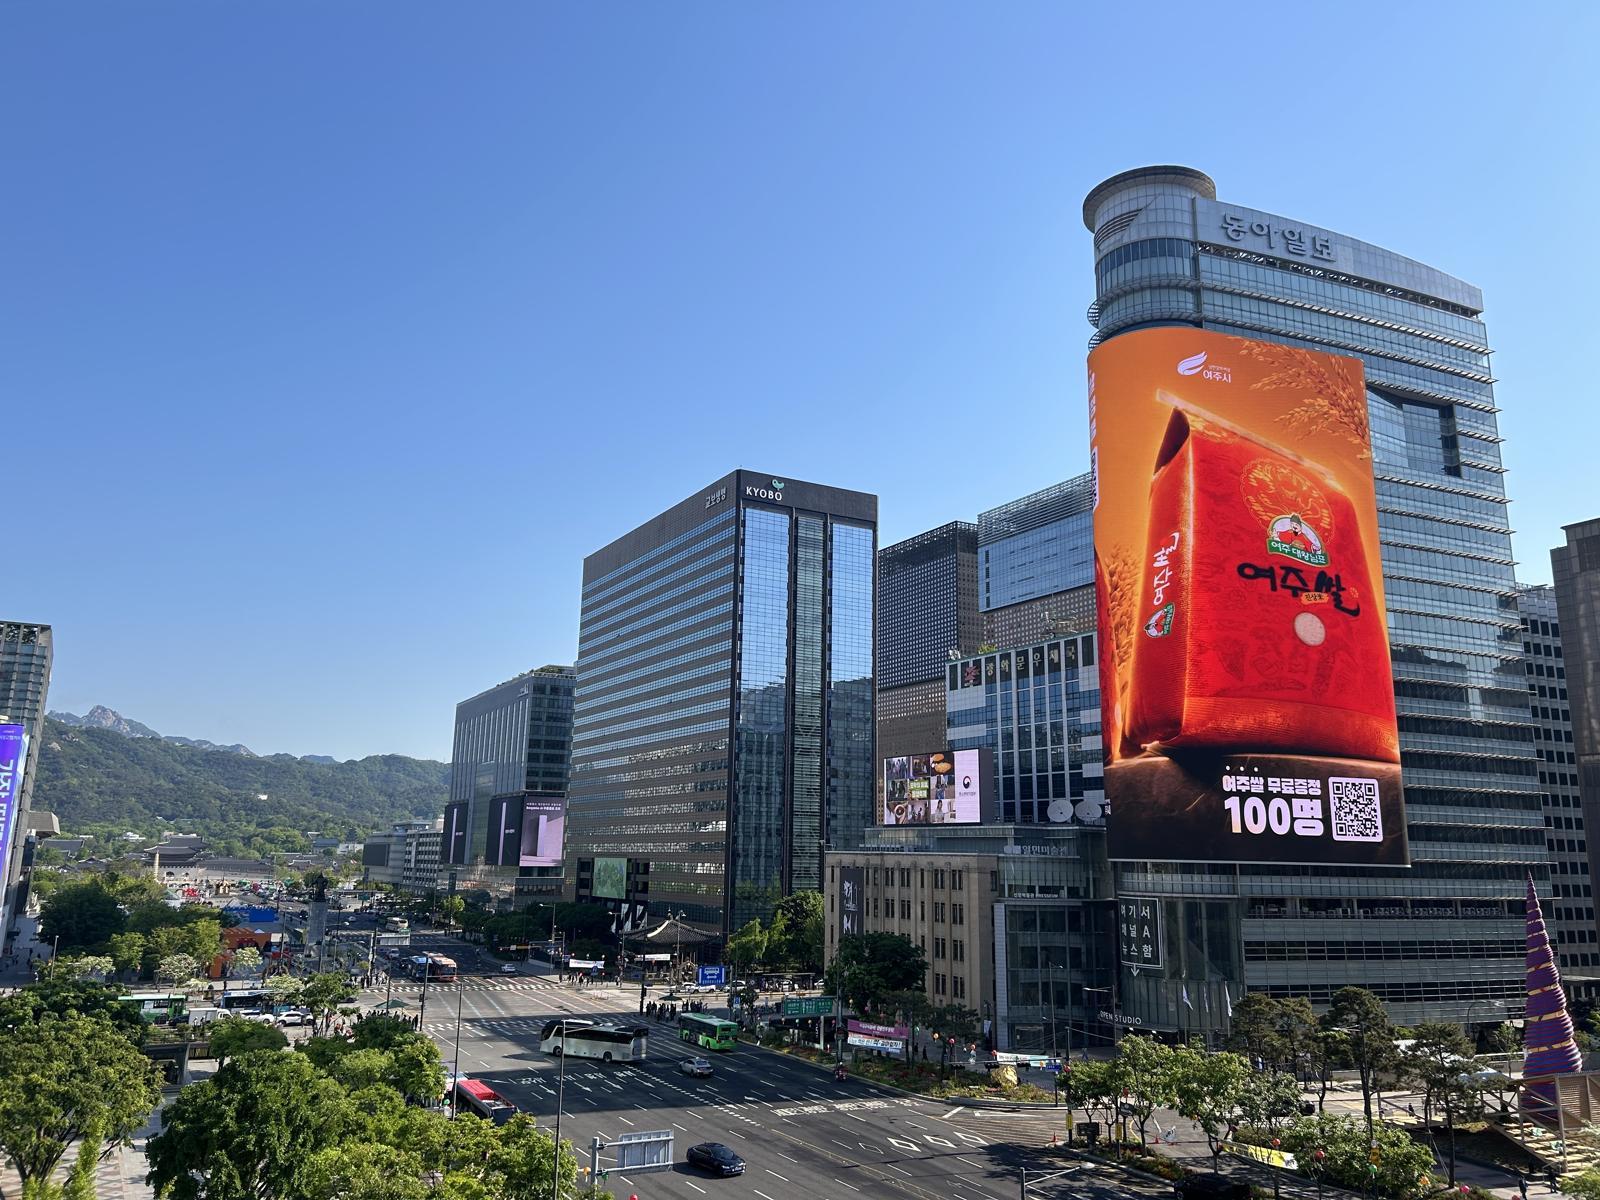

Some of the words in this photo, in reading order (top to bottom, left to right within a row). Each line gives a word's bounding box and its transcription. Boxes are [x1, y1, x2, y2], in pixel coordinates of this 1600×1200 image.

[1221, 212, 1336, 262] 동아일보
[1203, 370, 1231, 383] 여주시
[746, 486, 782, 501] KYOBO
[1271, 542, 1290, 553] 여주
[1292, 548, 1326, 564] 대왕님표
[1153, 532, 1179, 606] 여주쌀
[1237, 563, 1360, 617] 여주쌀
[986, 646, 1076, 676] 광화문우체국
[1222, 775, 1264, 793] 여주쌀
[1267, 777, 1322, 795] 무료증정
[1224, 796, 1324, 837] 100명
[1121, 905, 1150, 919] 여기서
[1122, 923, 1151, 938] 채널A
[1122, 942, 1152, 958] 뉴스함
[1114, 1014, 1142, 1024] STUDIO
